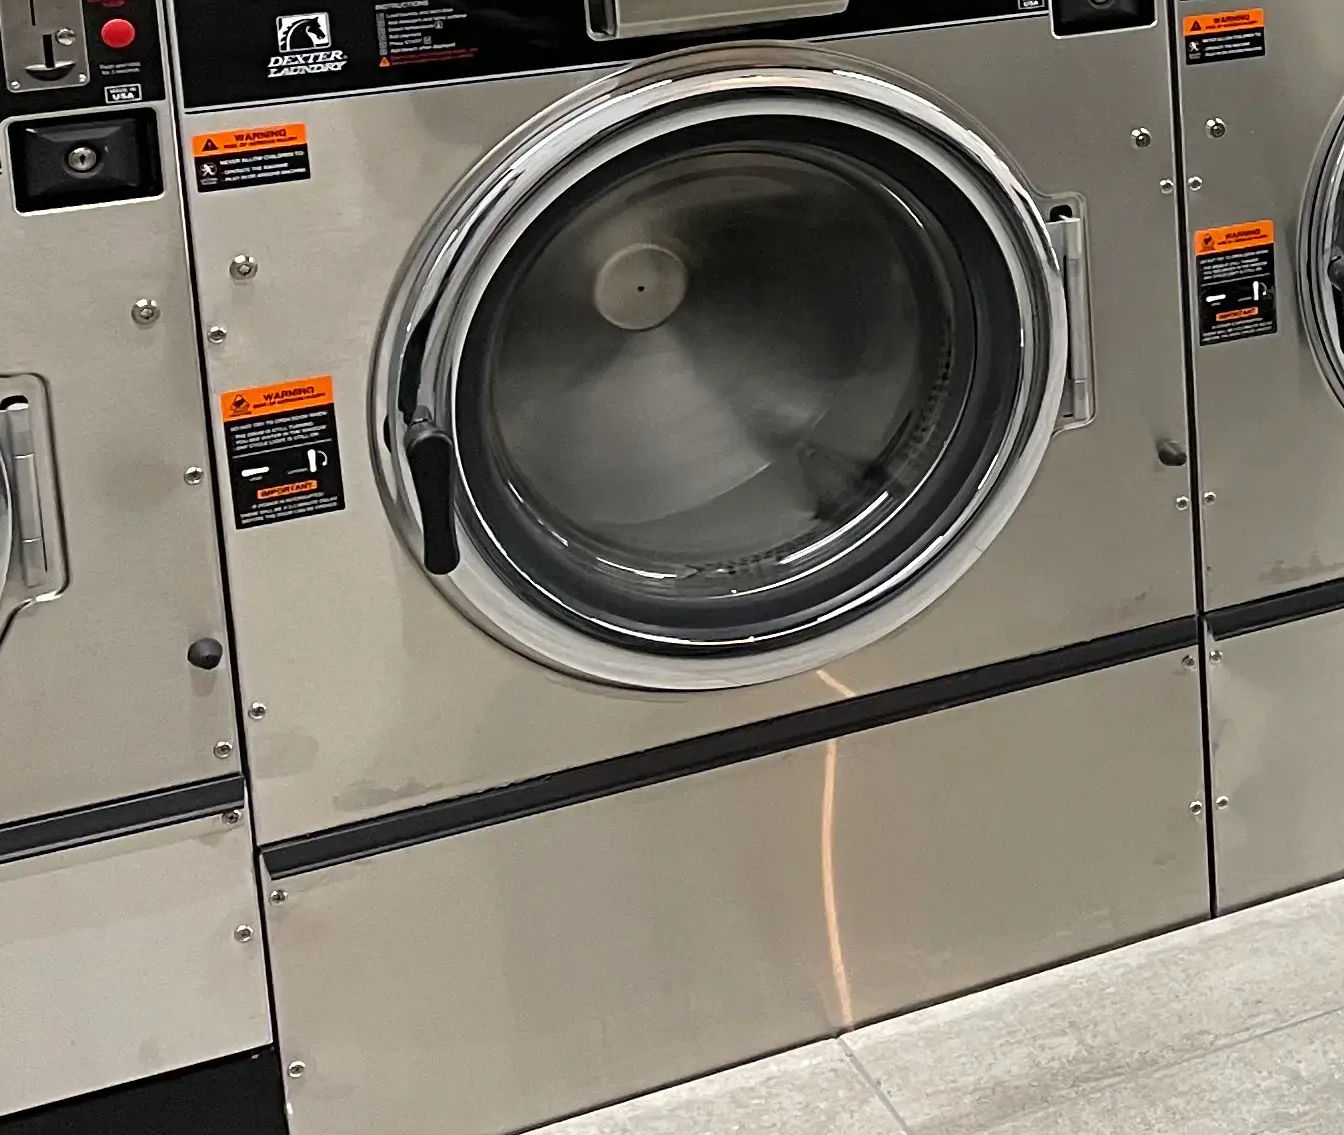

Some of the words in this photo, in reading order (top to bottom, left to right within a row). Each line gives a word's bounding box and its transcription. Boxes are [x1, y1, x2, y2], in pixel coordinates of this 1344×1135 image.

[268, 50, 344, 67] DEXTER
[112, 93, 134, 101] USA
[234, 129, 286, 141] WARNING
[263, 386, 314, 401] WARNING
